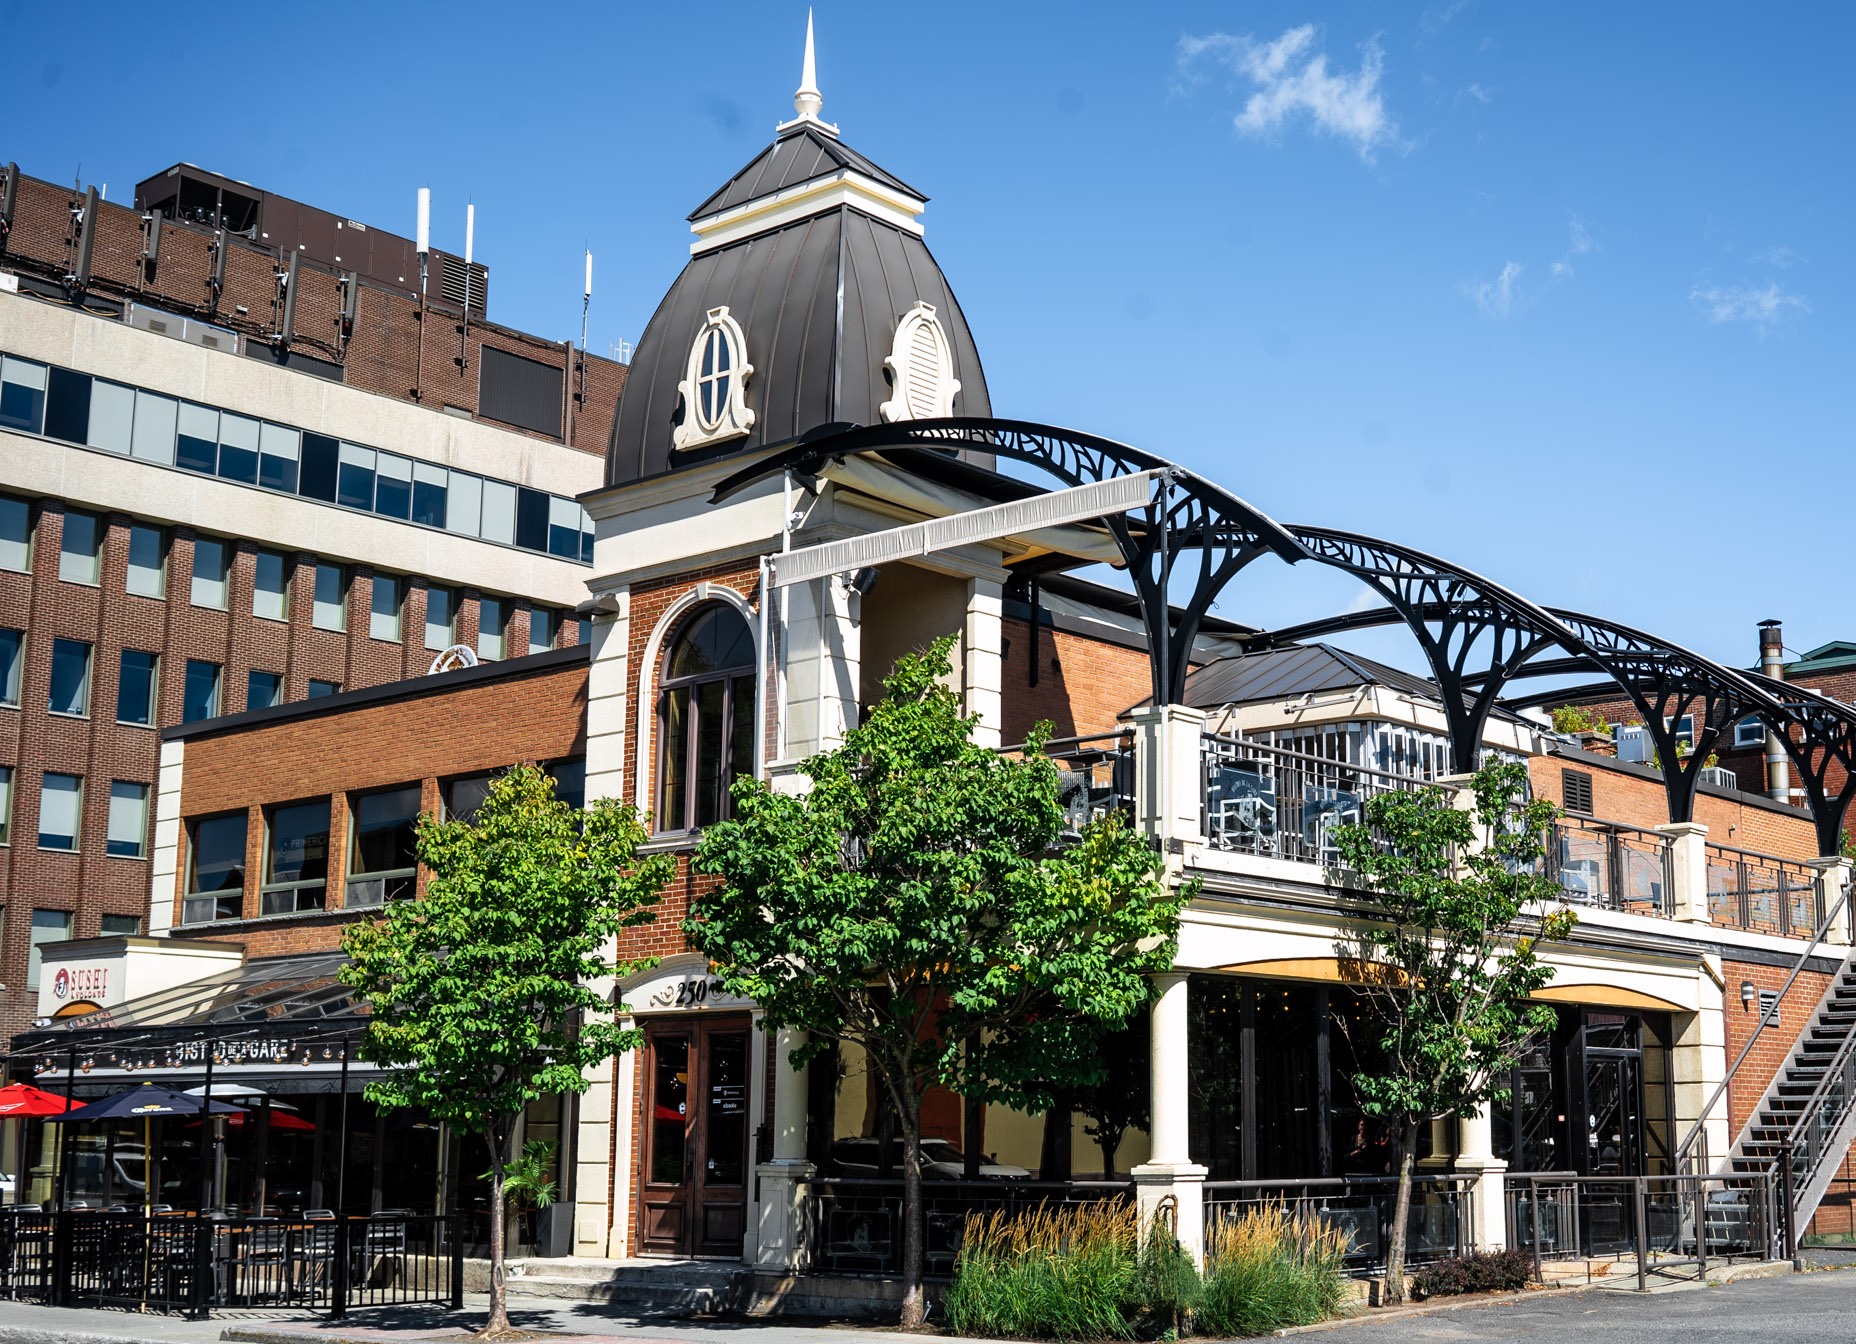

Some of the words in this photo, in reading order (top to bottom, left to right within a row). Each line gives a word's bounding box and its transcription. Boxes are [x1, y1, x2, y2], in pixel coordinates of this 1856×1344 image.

[291, 836, 327, 848] PRIMERIC
[71, 968, 108, 991] SUSHI
[675, 980, 707, 1005] 250
[175, 1041, 226, 1060] BISTO
[250, 1040, 288, 1058] GARE
